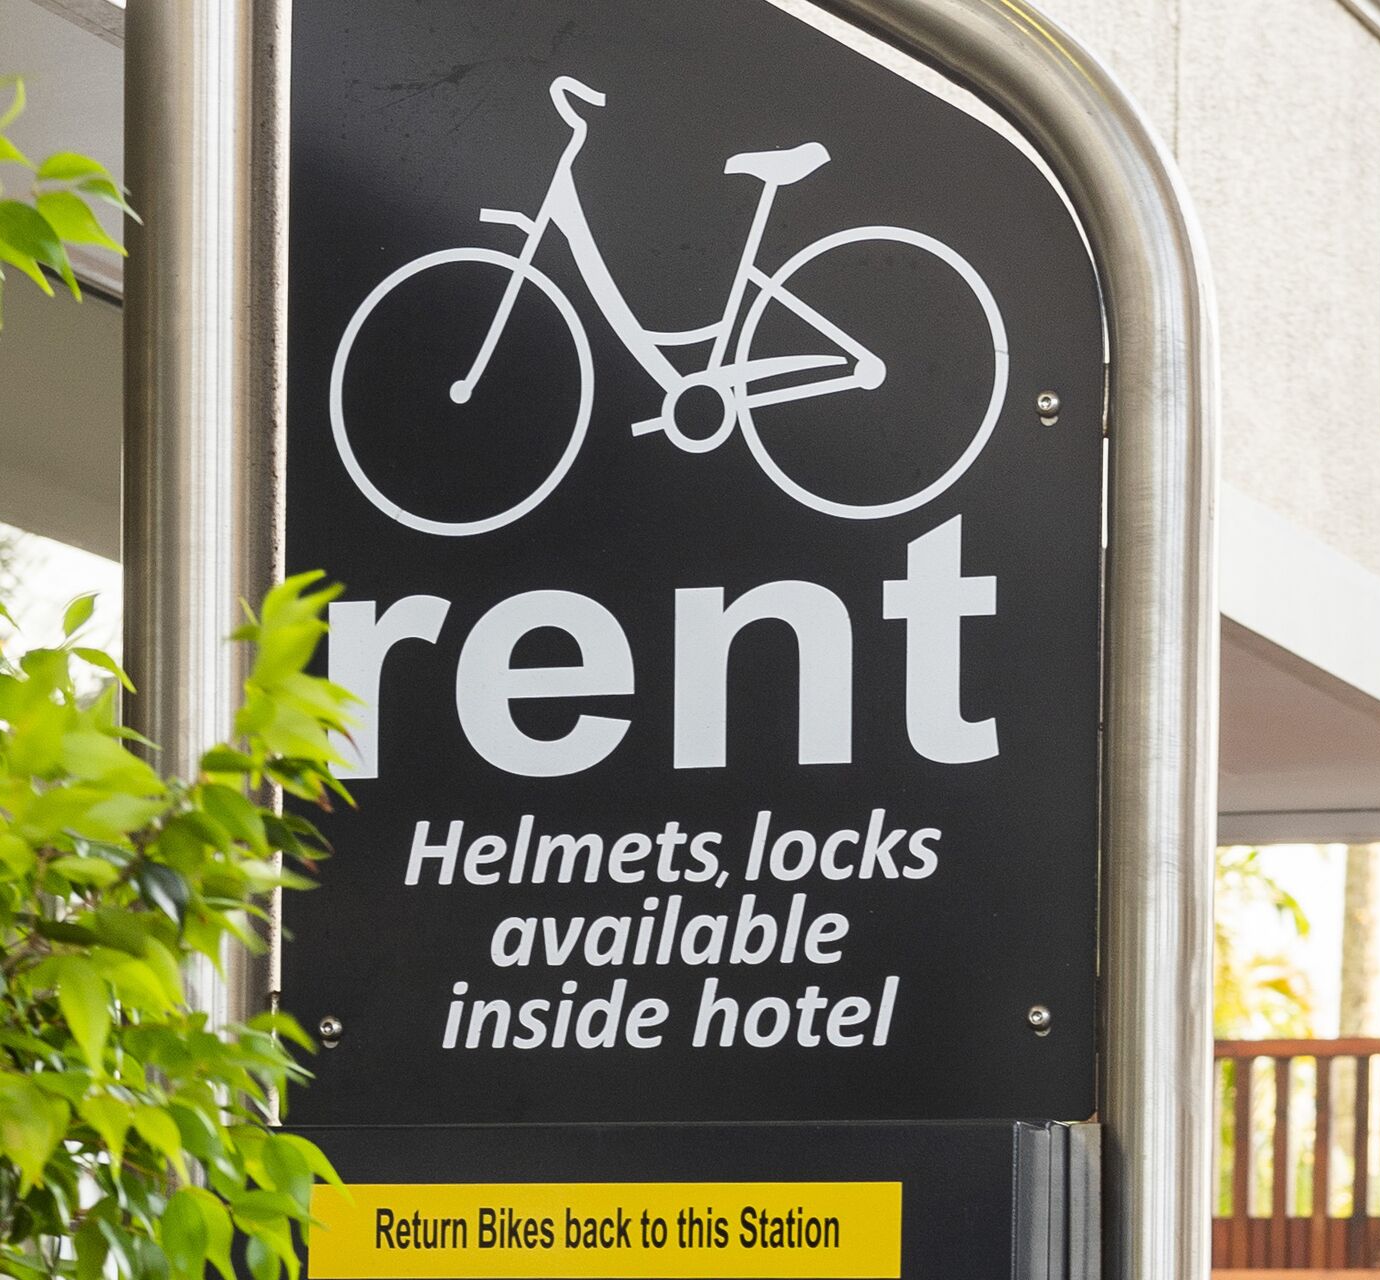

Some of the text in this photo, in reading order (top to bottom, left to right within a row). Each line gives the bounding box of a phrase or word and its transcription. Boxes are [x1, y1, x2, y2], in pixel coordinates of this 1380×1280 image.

[327, 514, 999, 780] rent
[404, 808, 941, 889] Helmets, locks
[490, 893, 850, 966] available
[442, 976, 900, 1050] inside hotel
[375, 1207, 840, 1249] Return Bikes back to this Station
